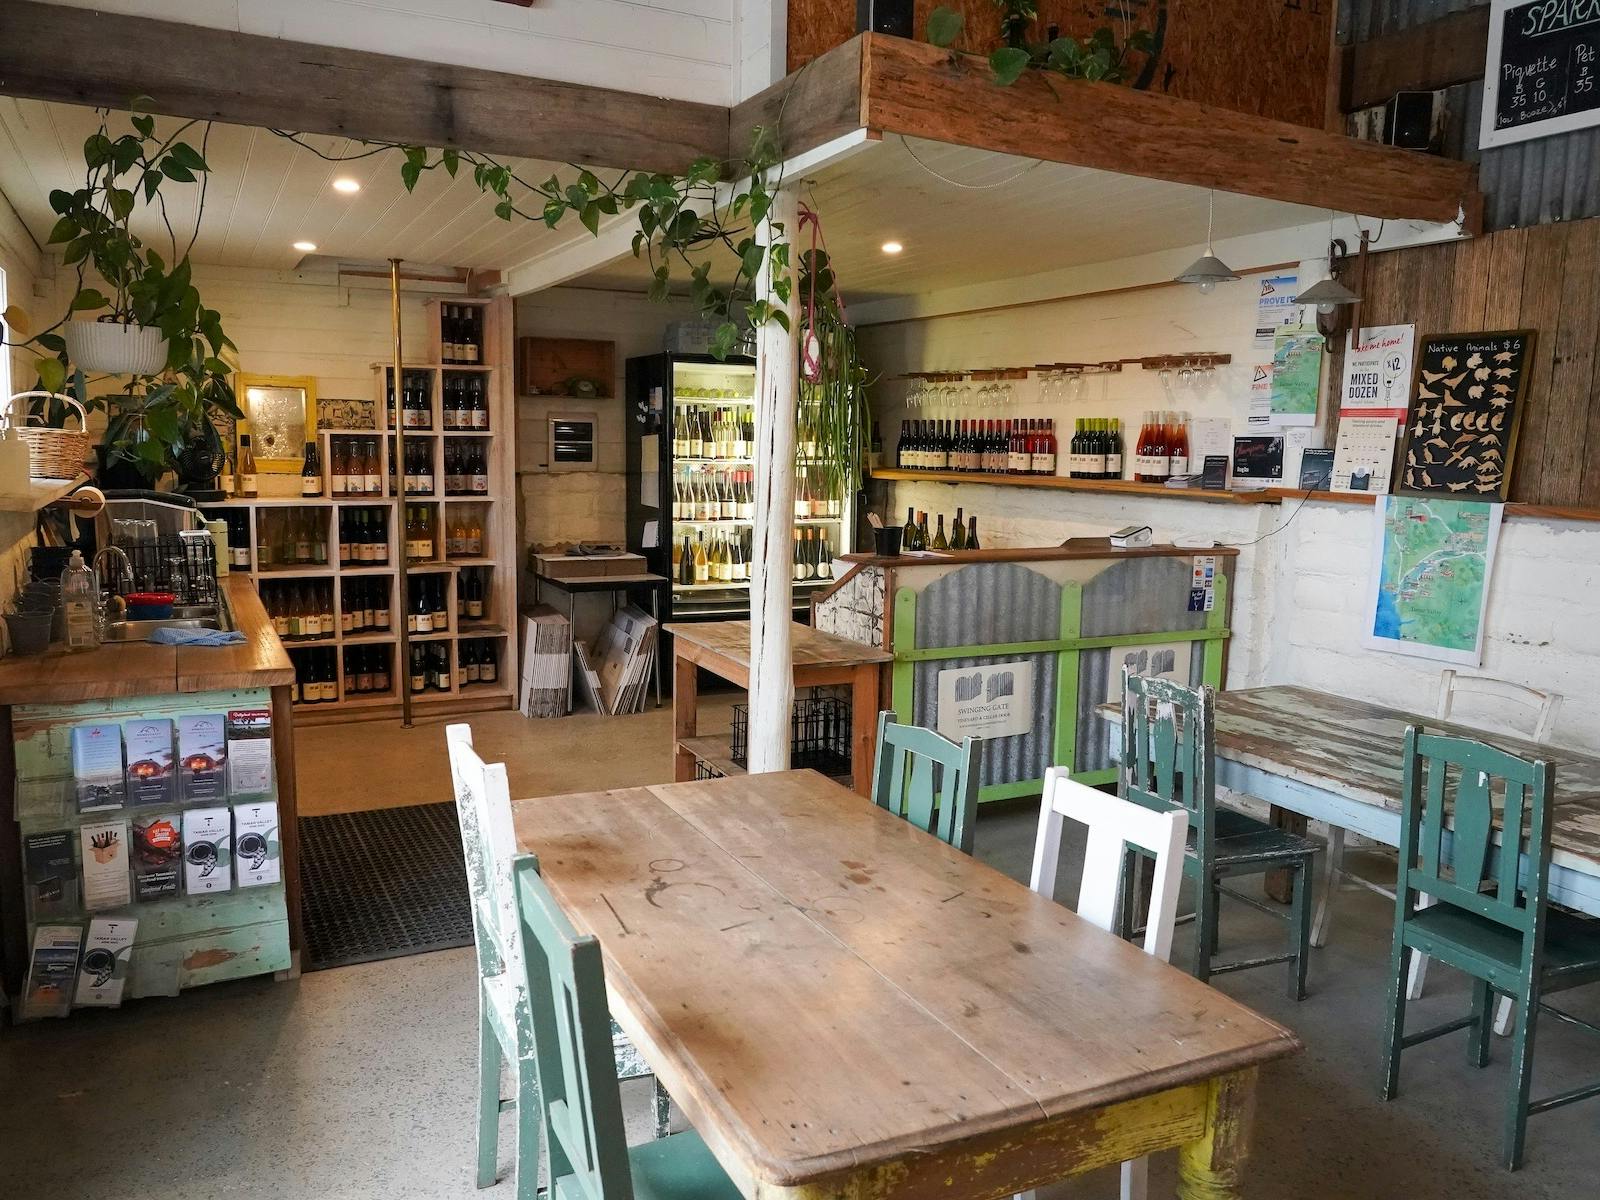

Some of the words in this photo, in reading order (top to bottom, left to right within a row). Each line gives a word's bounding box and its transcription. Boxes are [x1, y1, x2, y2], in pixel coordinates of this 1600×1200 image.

[1503, 56, 1557, 81] Piquette
[1575, 43, 1596, 64] Pet
[1510, 94, 1527, 109] 35
[1533, 90, 1547, 103] 10
[1574, 75, 1594, 94] 35
[1259, 296, 1285, 305] PROVE
[1428, 343, 1459, 353] Native
[1350, 373, 1379, 386] MIXED
[1349, 387, 1378, 399] DOZEN
[958, 705, 991, 715] SWINGING
[993, 703, 1009, 712] GATE
